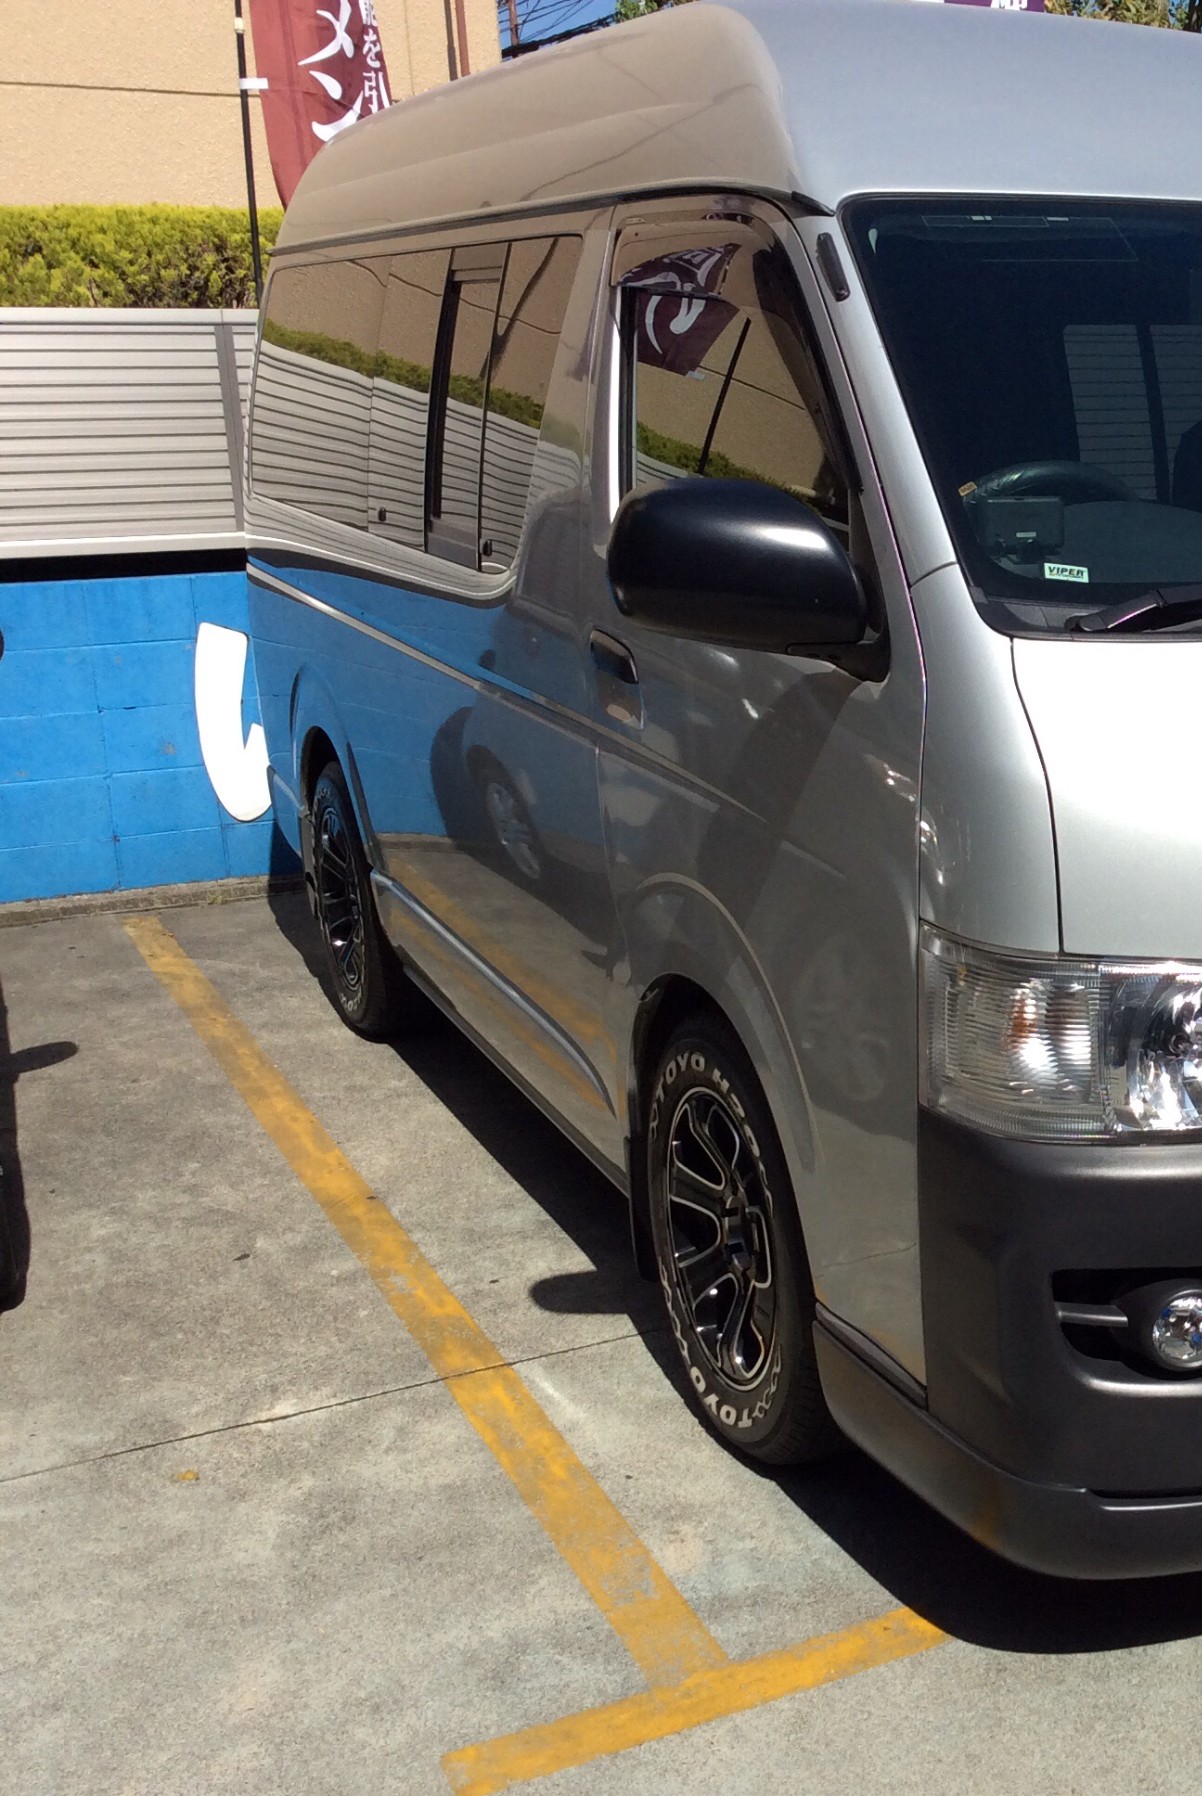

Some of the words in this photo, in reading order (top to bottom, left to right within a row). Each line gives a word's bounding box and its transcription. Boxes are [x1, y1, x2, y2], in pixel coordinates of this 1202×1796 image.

[1048, 566, 1085, 577] VIPER
[655, 1049, 706, 1103] TOYO
[690, 1365, 754, 1429] TOYO
